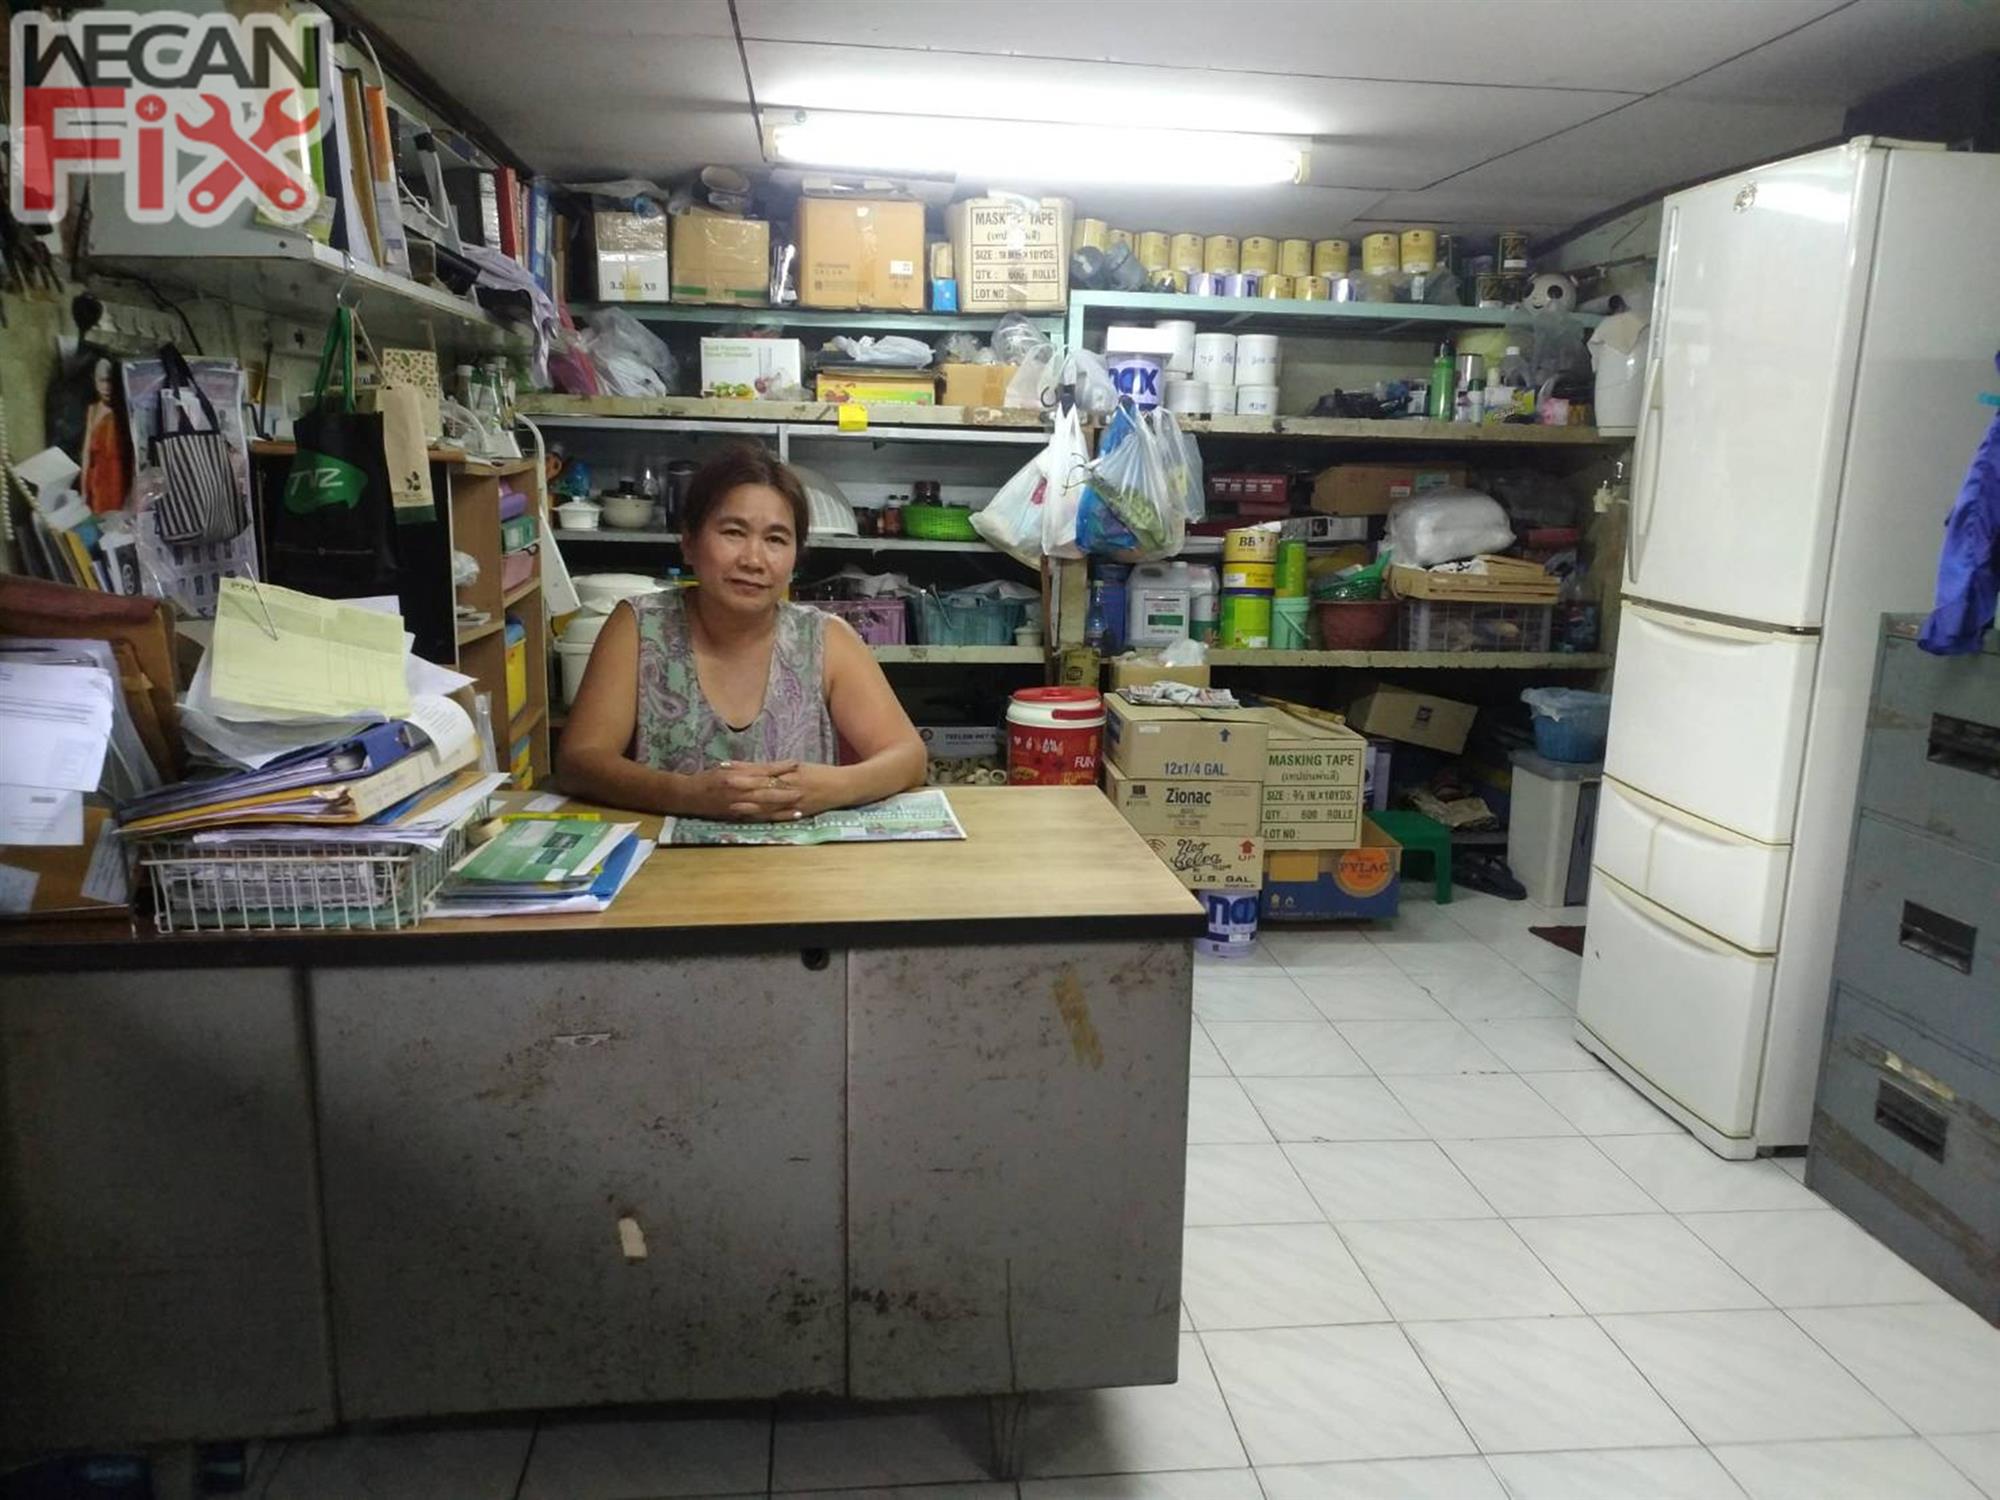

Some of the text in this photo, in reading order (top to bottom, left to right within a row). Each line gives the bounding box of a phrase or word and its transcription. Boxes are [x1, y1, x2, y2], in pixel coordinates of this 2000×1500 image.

[1030, 213, 1055, 226] TAPE
[974, 288, 990, 299] LOT
[1268, 754, 1355, 767] MASKING TAPE
[1166, 786, 1212, 804] Zionac
[1266, 789, 1284, 801] SIZE
[1238, 854, 1256, 863] UP
